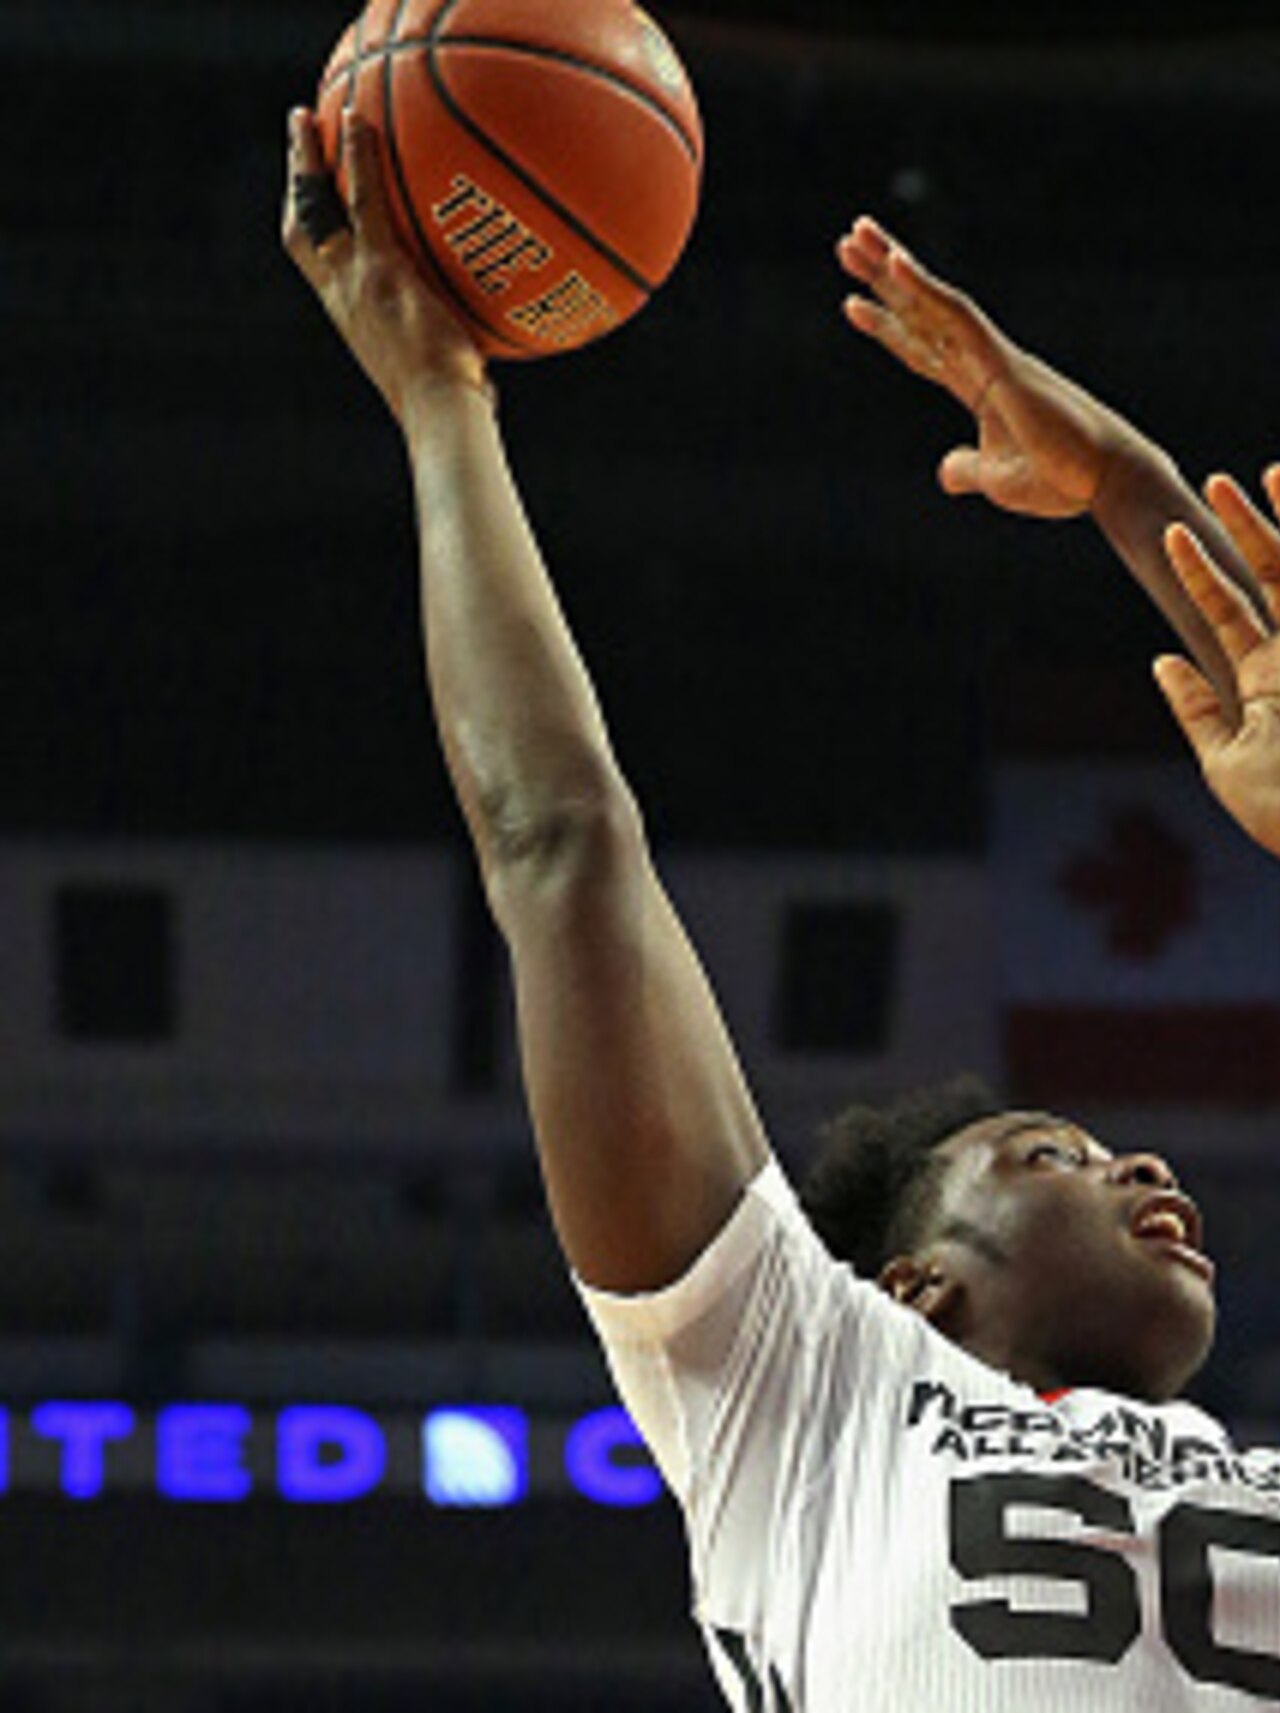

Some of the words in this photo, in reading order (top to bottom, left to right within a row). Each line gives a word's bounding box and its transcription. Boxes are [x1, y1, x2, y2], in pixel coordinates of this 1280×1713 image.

[432, 174, 553, 295] THE
[0, 1400, 388, 1502] TED
[563, 1402, 663, 1507] C
[931, 1428, 1036, 1460] ALL
